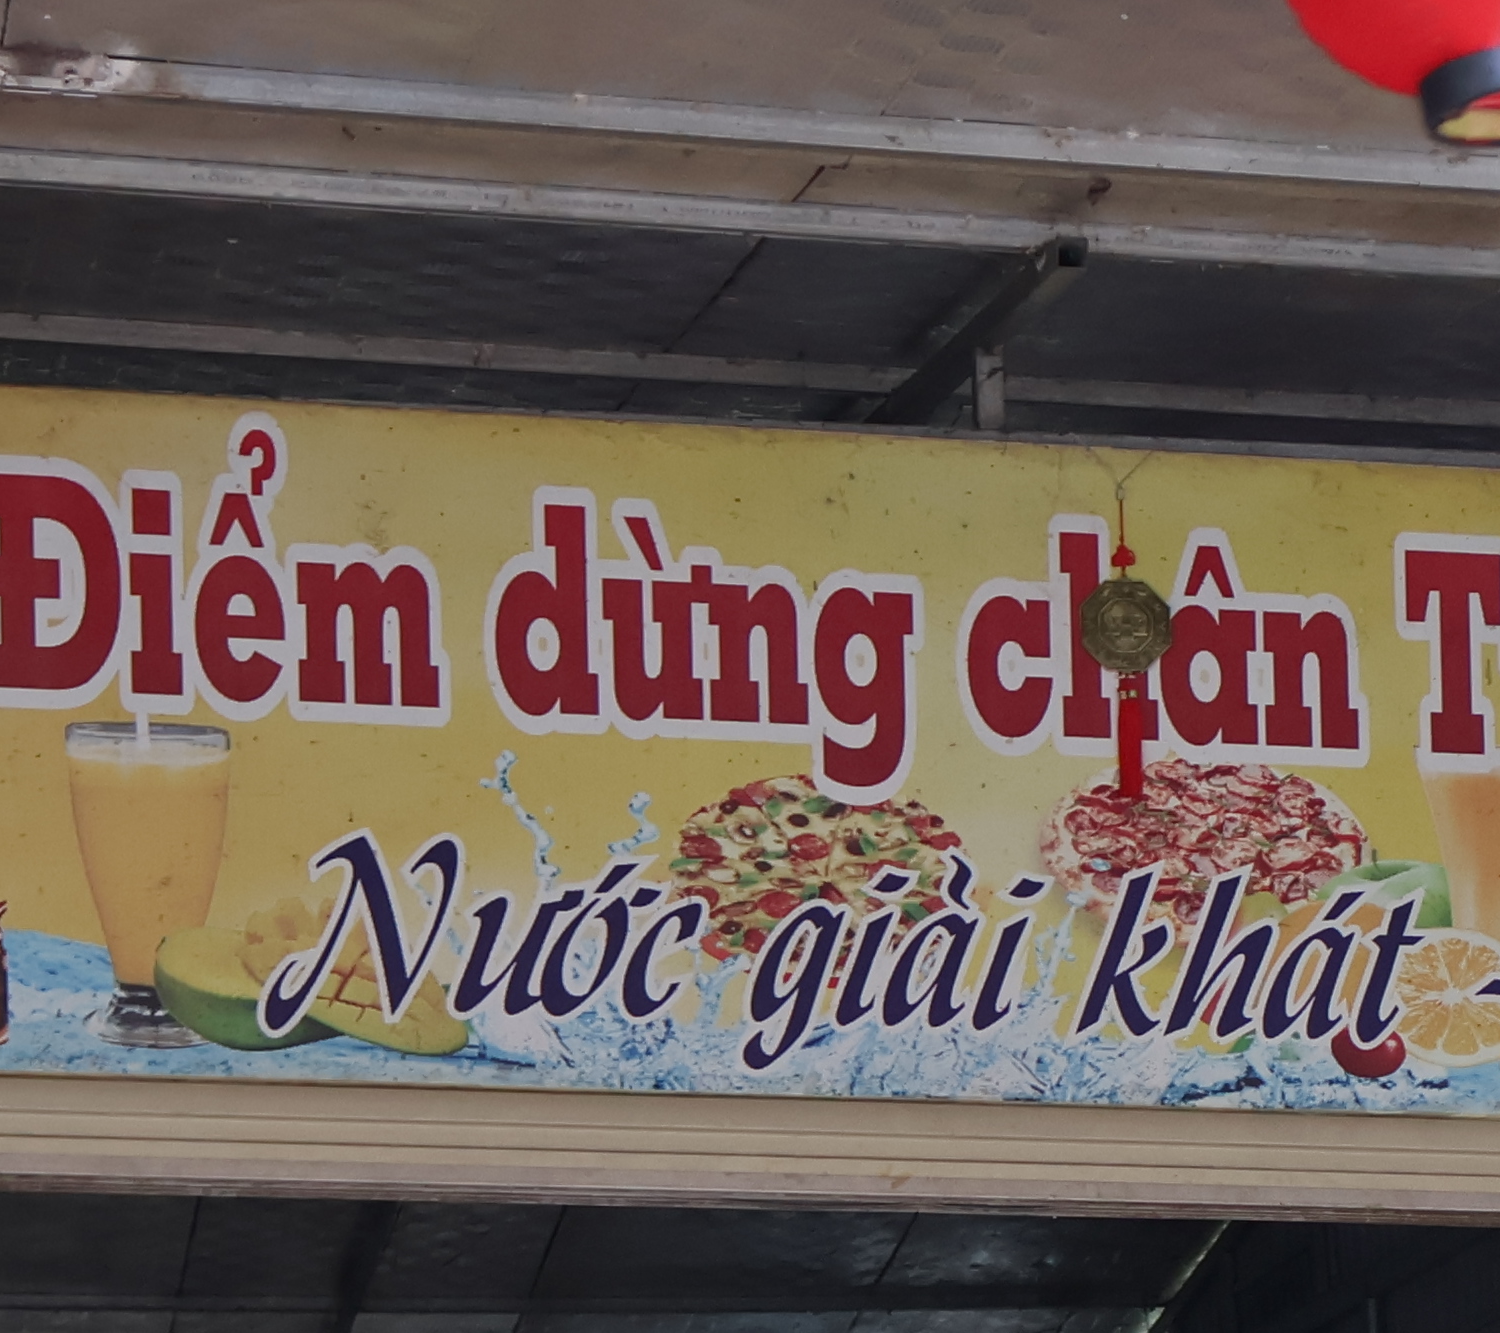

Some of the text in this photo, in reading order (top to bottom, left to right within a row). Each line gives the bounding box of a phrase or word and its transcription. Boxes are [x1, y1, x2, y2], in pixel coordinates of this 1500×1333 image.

[501, 503, 913, 787] dừng
[967, 515, 1361, 749] chân
[270, 835, 706, 1035] Nước
[743, 857, 1045, 1069] giải
[1079, 871, 1420, 1040] khát
